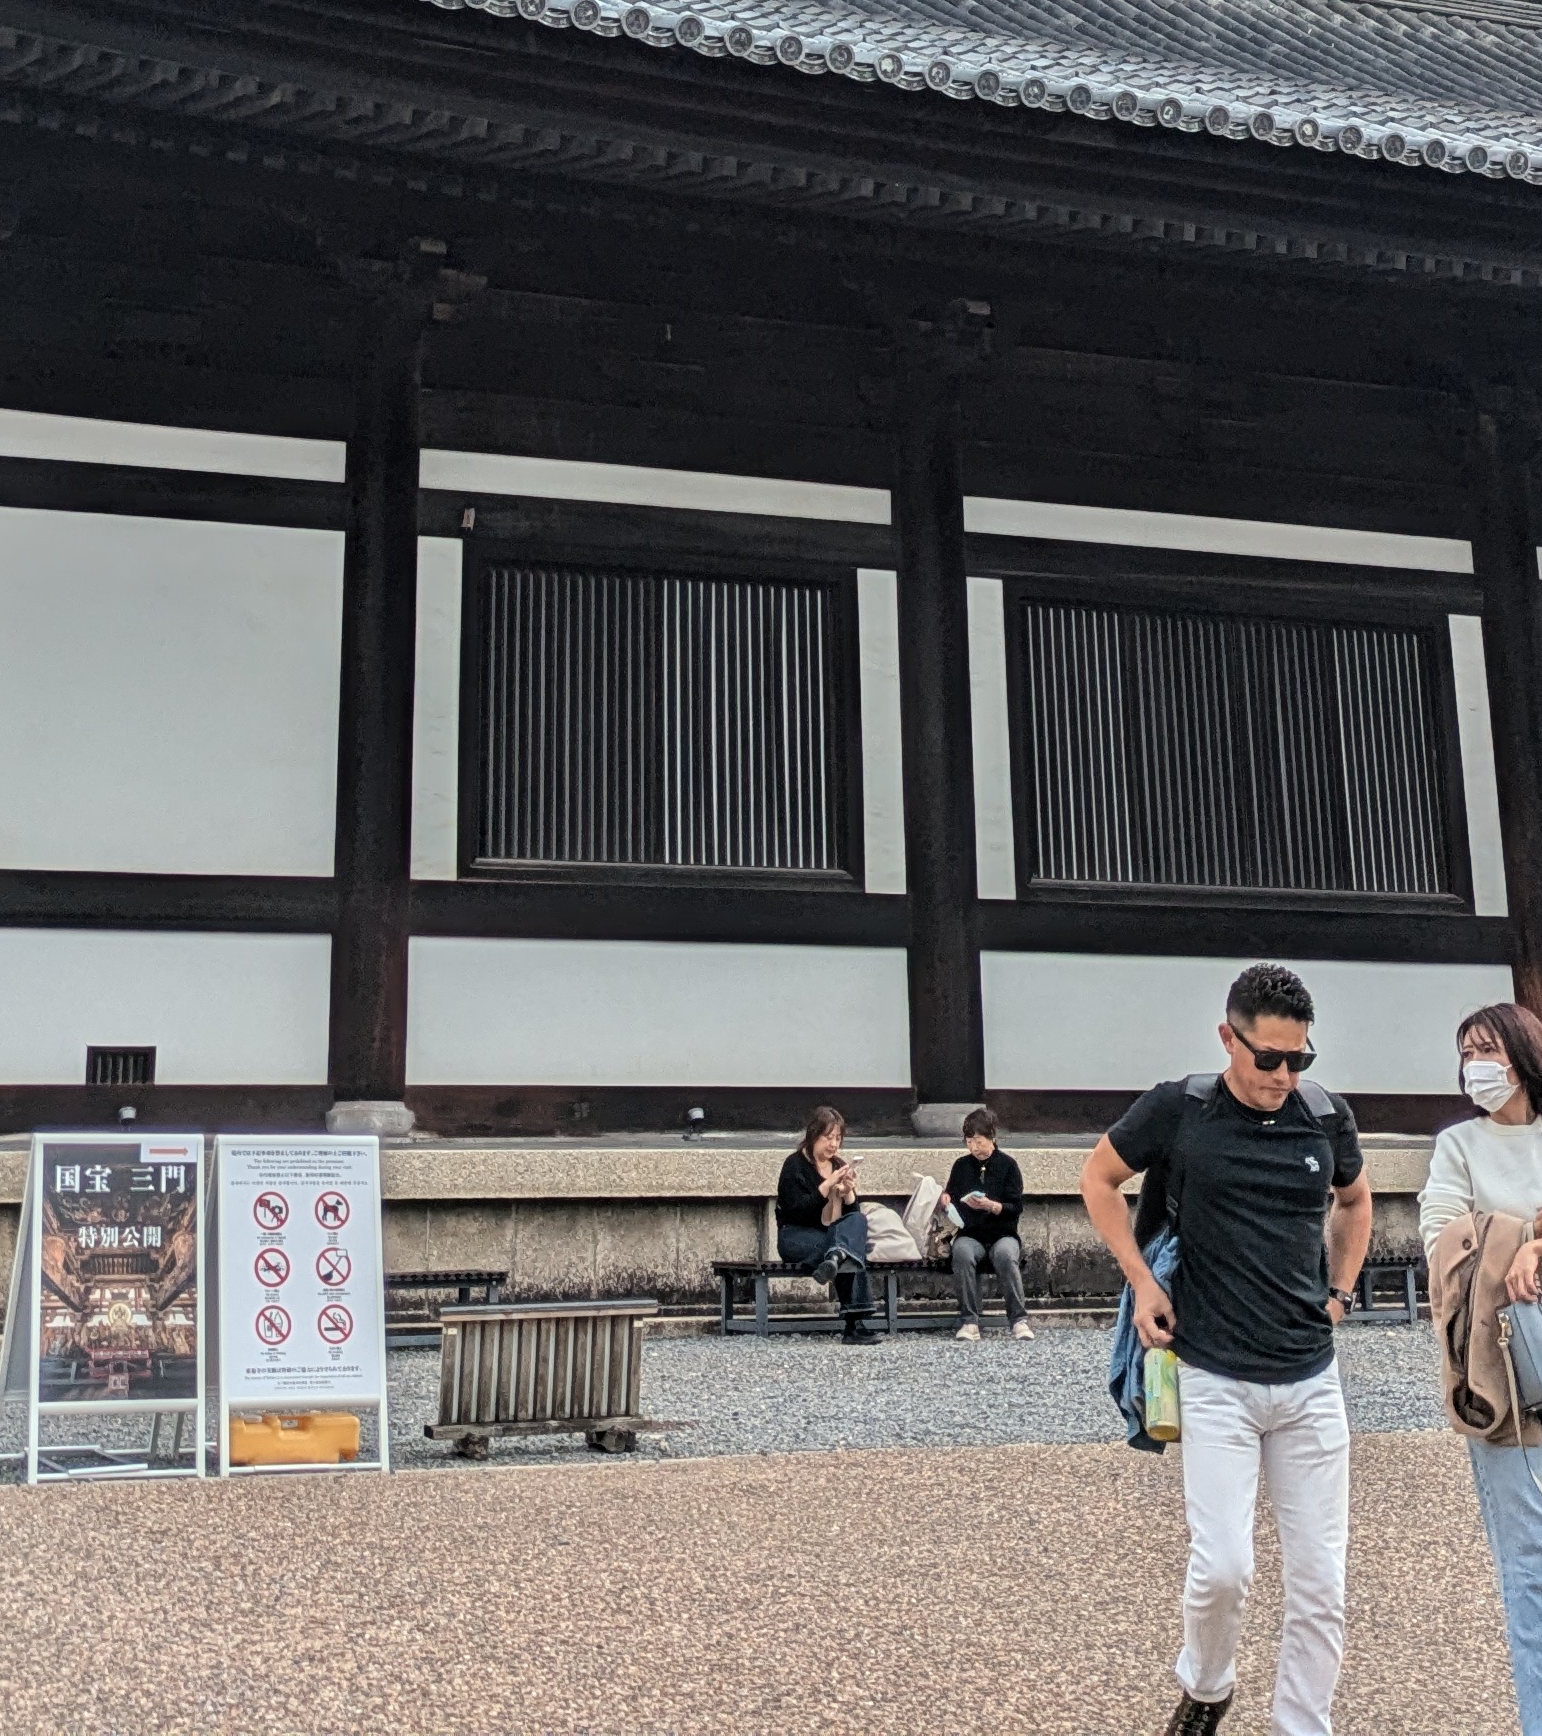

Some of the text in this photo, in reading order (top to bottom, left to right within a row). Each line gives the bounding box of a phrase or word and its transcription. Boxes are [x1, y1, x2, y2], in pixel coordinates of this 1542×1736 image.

[56, 1165, 186, 1193] 国宝 三門
[78, 1225, 162, 1248] 特別公開
